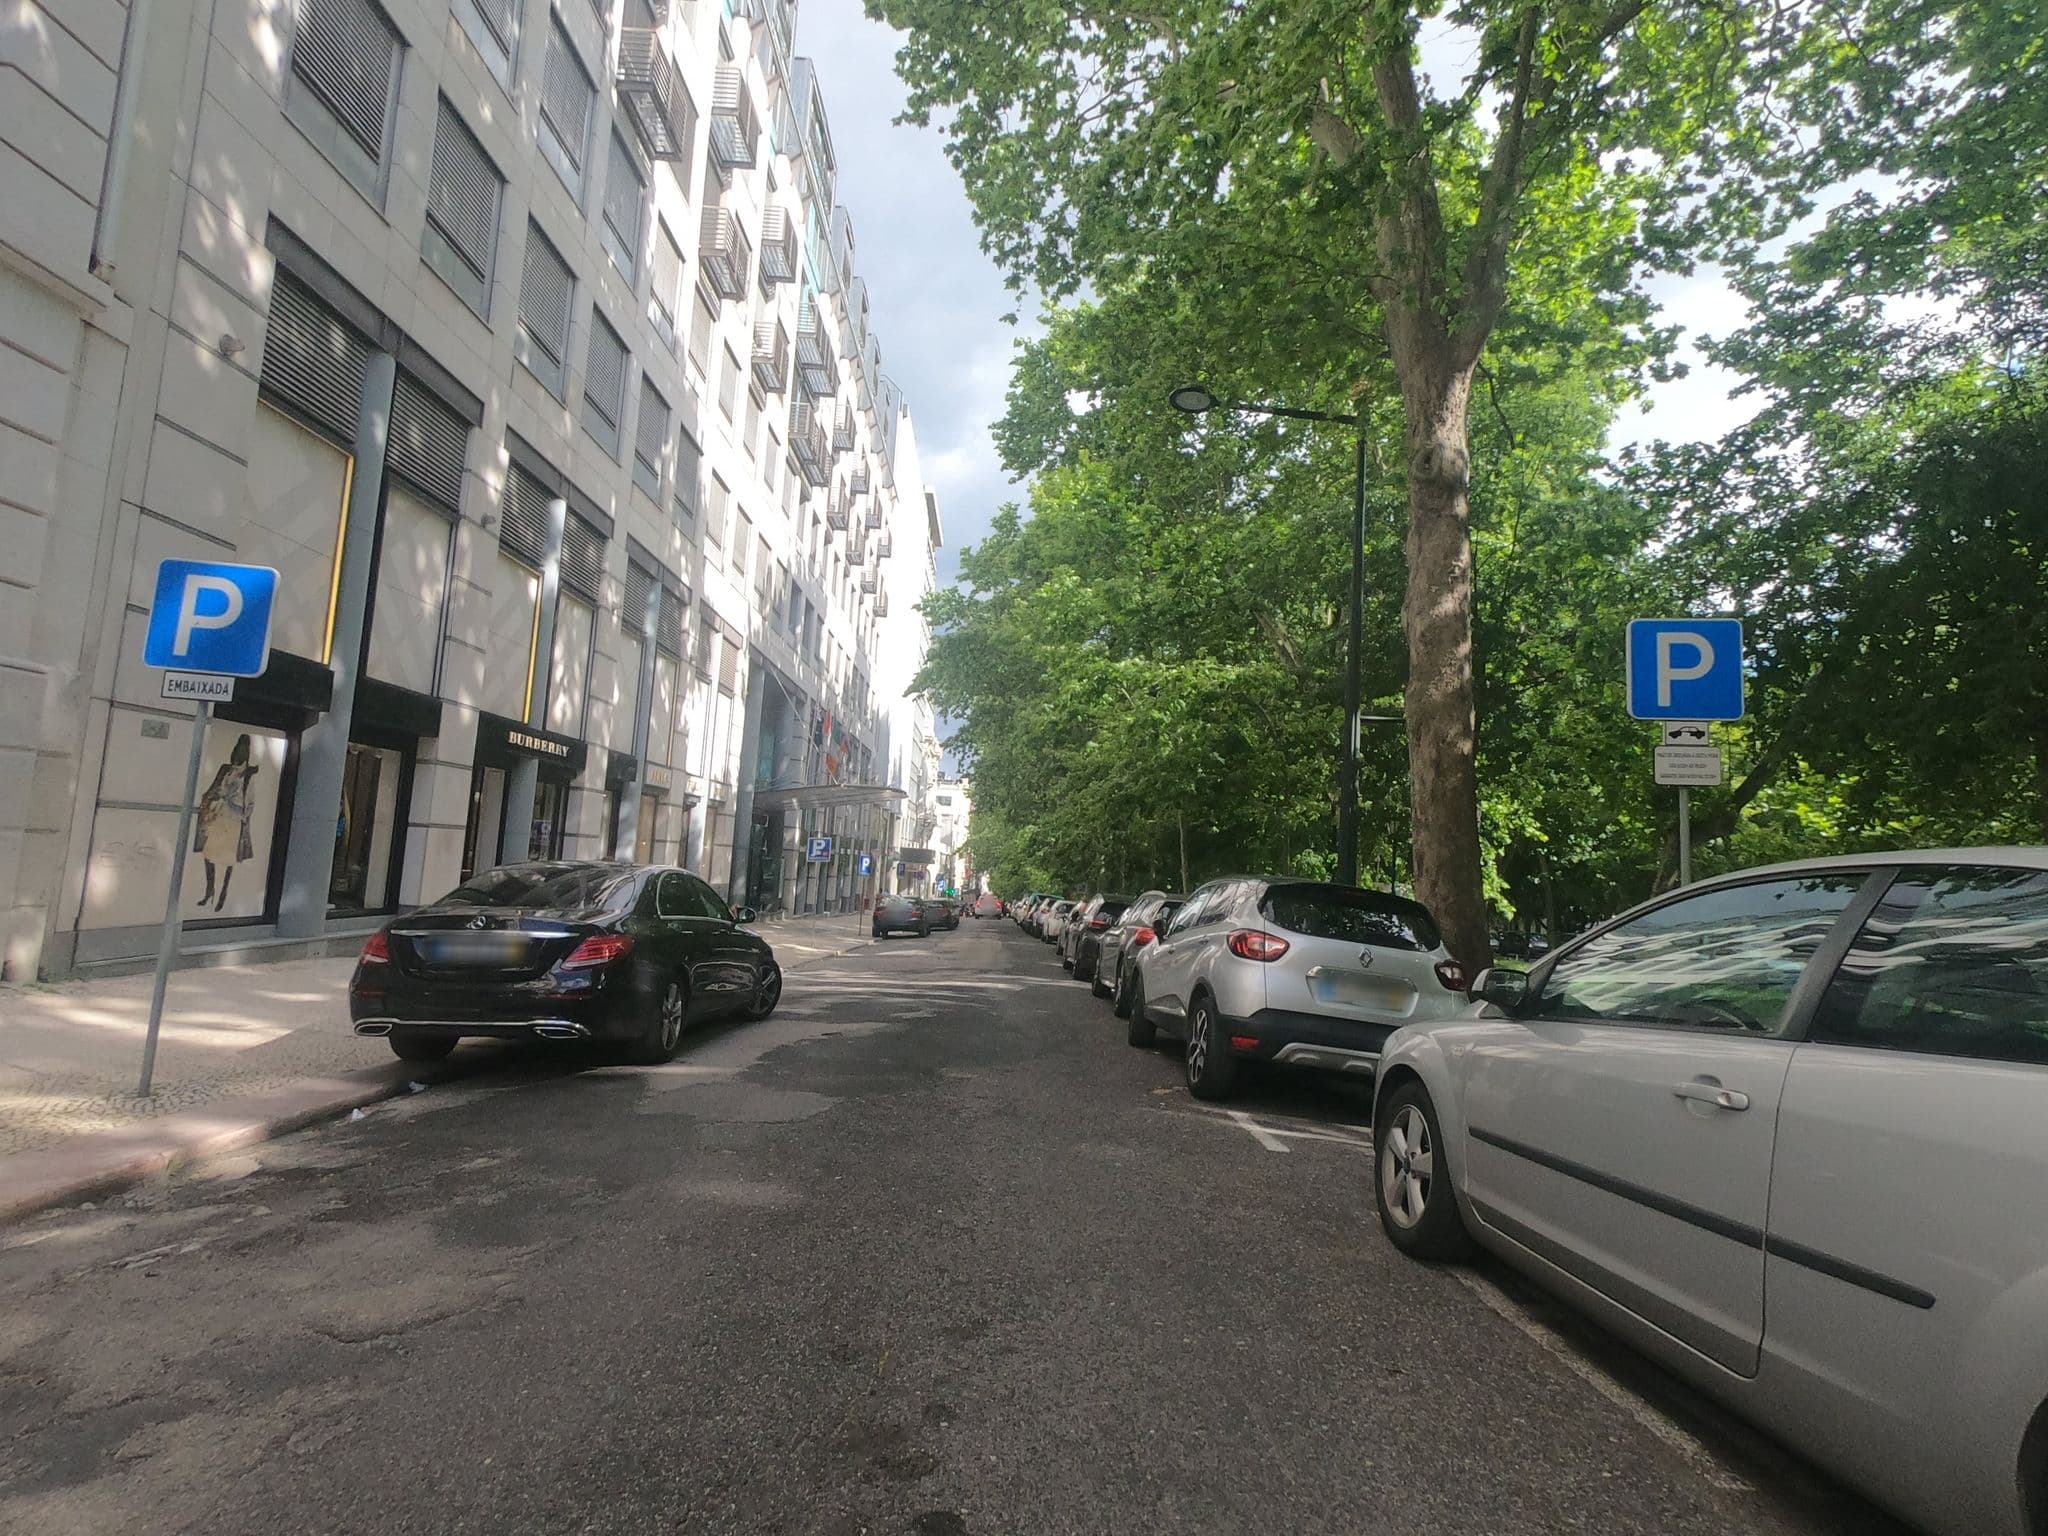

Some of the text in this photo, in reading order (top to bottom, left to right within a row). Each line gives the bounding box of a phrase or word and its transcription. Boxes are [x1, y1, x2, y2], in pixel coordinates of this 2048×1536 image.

[173, 574, 244, 656] P
[1656, 632, 1715, 707] P
[167, 679, 230, 696] EMBAIXADA
[508, 731, 570, 757] BURBERRY
[861, 857, 870, 872] P
